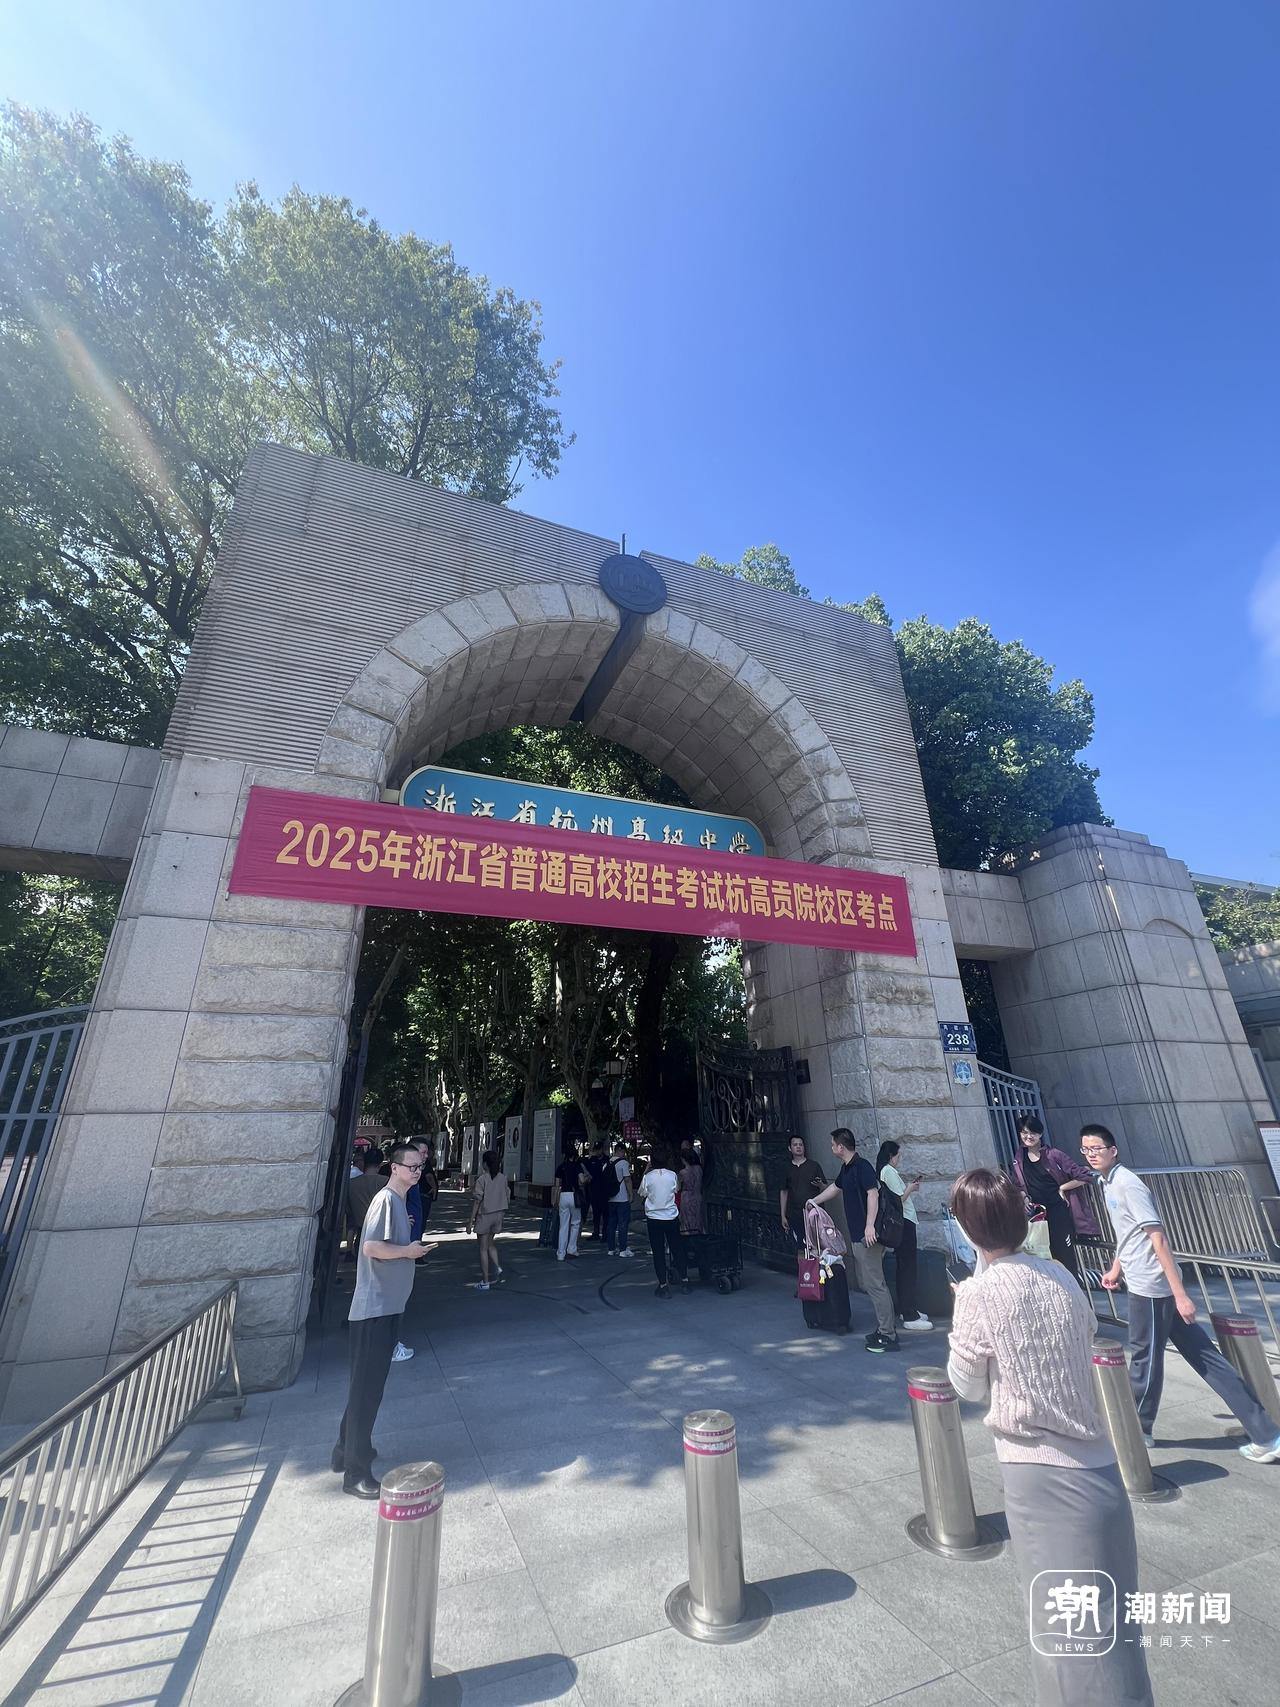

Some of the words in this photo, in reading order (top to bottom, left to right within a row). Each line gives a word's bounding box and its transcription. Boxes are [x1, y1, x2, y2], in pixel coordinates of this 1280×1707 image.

[275, 819, 898, 932] 2025年浙江省普通高校招生考试杭高贡院校区考点
[947, 1033, 970, 1045] 238
